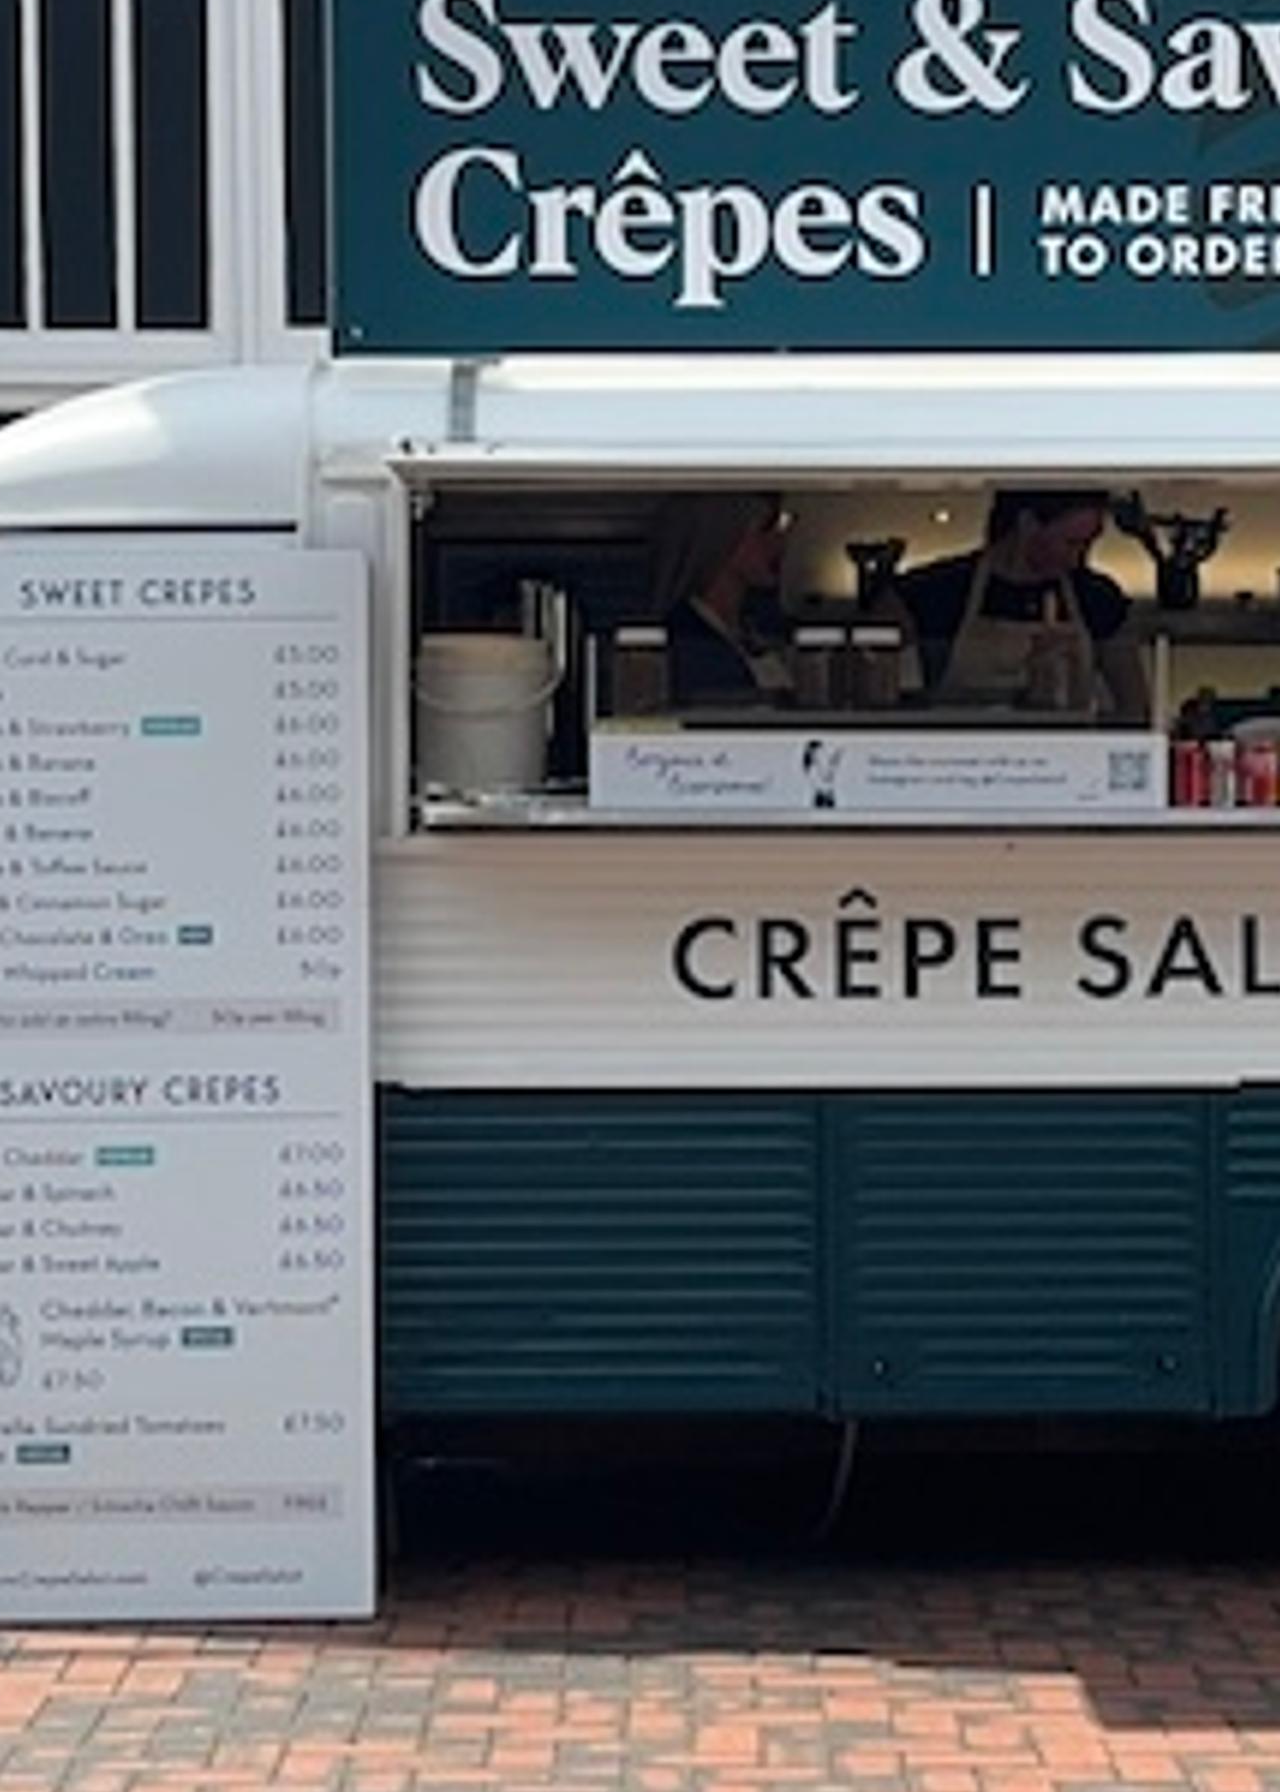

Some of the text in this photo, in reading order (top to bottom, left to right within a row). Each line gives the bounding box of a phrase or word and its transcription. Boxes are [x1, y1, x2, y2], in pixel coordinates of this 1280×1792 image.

[1040, 187, 1193, 224] MADE
[414, 146, 925, 309] Crêpes
[1040, 238, 1112, 276] TO
[19, 578, 257, 609] SWEET CREPES
[56, 649, 71, 666] &
[75, 647, 126, 671] Sugar
[273, 644, 340, 665] £5.00
[274, 679, 340, 700] £5.00
[8, 719, 22, 737] &
[27, 717, 131, 739] Strawberry
[8, 754, 22, 772] &
[27, 752, 96, 772] Banana
[8, 789, 22, 807] &
[4, 824, 17, 843] &
[24, 823, 94, 842] Banana
[9, 859, 23, 877] &
[116, 891, 166, 916] Sugar
[99, 928, 113, 946] &
[672, 887, 1025, 1000] CRÊPE
[92, 961, 156, 981] Cream
[161, 1074, 281, 1106] CREPES
[2, 1147, 85, 1167] Cheddar
[22, 1184, 36, 1202] &
[41, 1182, 116, 1205] Spinach
[21, 1219, 36, 1238] &
[39, 1217, 123, 1239] Chutney
[21, 1255, 36, 1274] &
[40, 1254, 100, 1273] Sweet
[104, 1256, 161, 1275] Apple
[141, 1298, 206, 1319] Bacon
[212, 1298, 227, 1317] &
[39, 1332, 106, 1352] Maple
[110, 1327, 172, 1352] Syrup
[44, 1415, 130, 1436] Sundried
